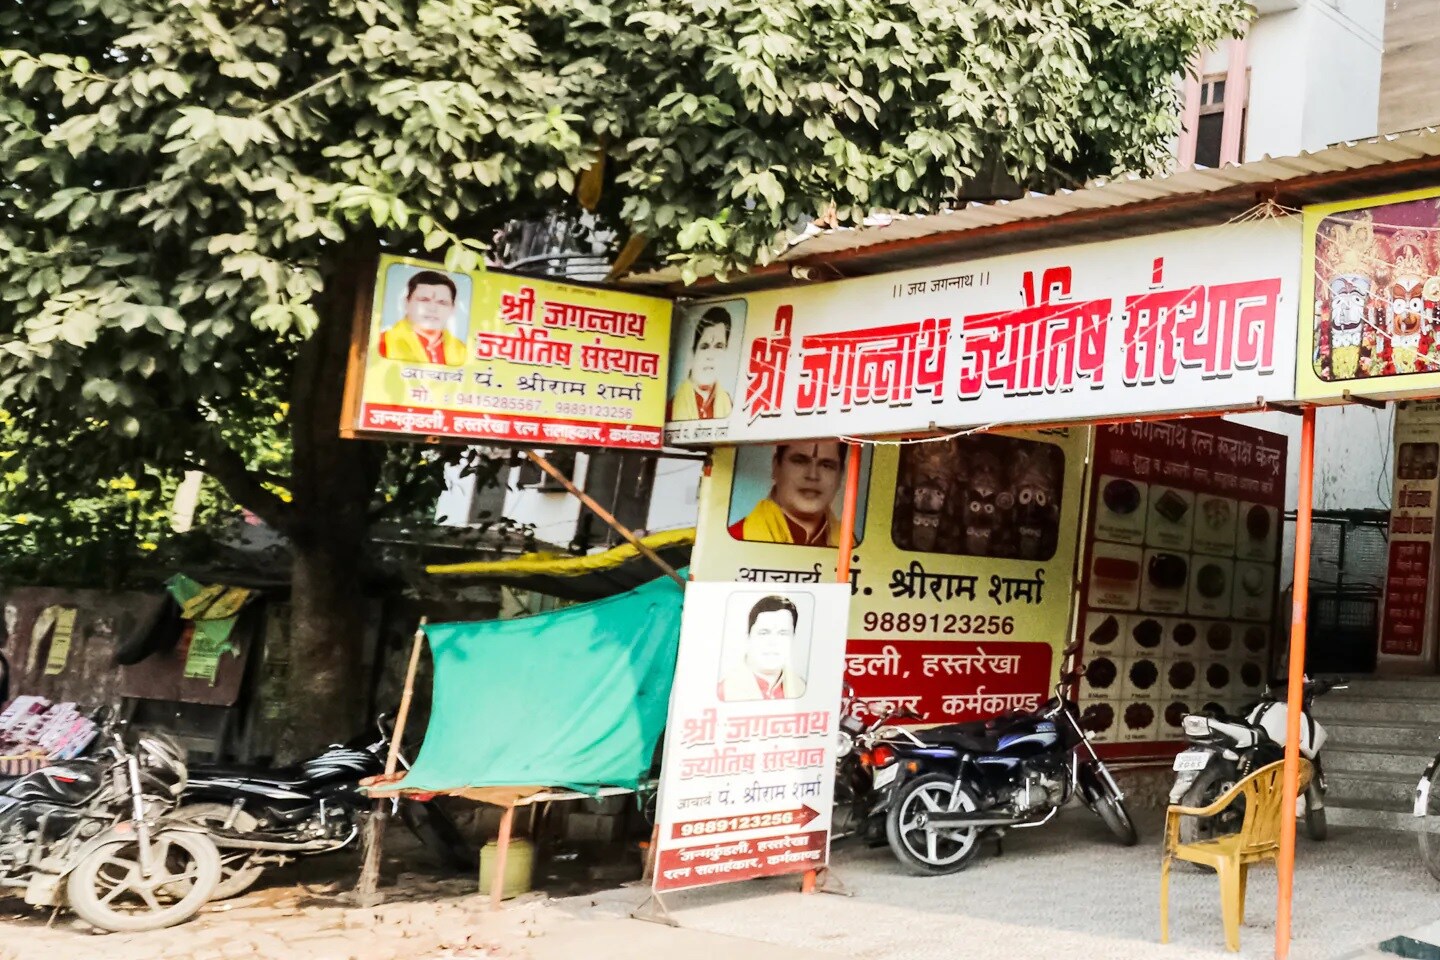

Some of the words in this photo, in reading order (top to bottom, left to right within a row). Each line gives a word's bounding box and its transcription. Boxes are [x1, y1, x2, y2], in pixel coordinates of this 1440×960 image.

[907, 281, 927, 296] जय
[930, 274, 975, 293] जगन्नाथ
[500, 286, 536, 324] श्री
[543, 300, 648, 339] जगन्नाथ
[477, 328, 573, 367] ज्योतिष
[581, 338, 660, 377] संस्थान
[744, 304, 795, 421] श्री
[795, 317, 952, 414] जगन्नाथ
[958, 265, 1114, 398] ज्योतिष
[1122, 257, 1284, 385] संस्थान
[516, 371, 586, 396] श्रीराम
[596, 381, 643, 401] शर्मा
[555, 401, 633, 420] 9889123256
[889, 561, 979, 603] श्रीराम
[990, 568, 1046, 605] शर्मा
[863, 611, 1015, 636] 9889123256
[922, 646, 1022, 677] हस्तरेखा
[682, 707, 718, 745] श्री
[726, 710, 831, 742] जगन्नाथ
[679, 746, 756, 780] ज्योतिष
[761, 744, 825, 773] संस्थान
[742, 780, 787, 804] श्रीराम
[791, 774, 822, 798] शर्मा
[680, 812, 794, 837] 9889123256
